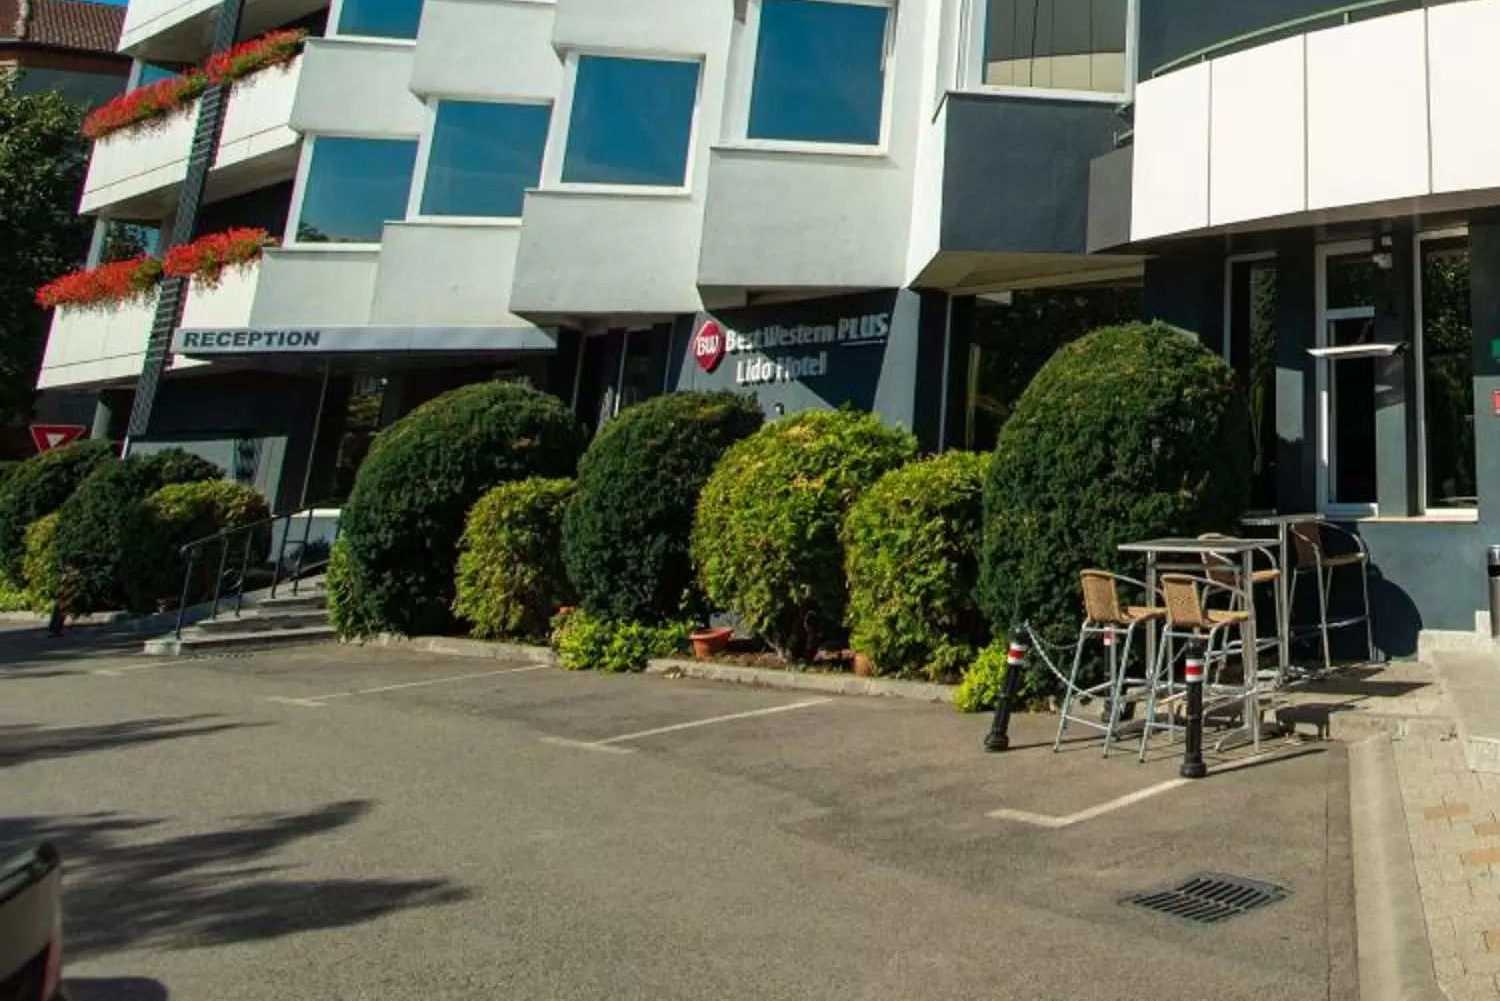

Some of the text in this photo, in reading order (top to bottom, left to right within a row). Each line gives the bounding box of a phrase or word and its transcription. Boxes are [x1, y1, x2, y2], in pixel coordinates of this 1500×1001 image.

[183, 330, 321, 347] RECEPTION
[725, 312, 891, 352] Best Western PLUS
[736, 352, 828, 384] Lido Hotel
